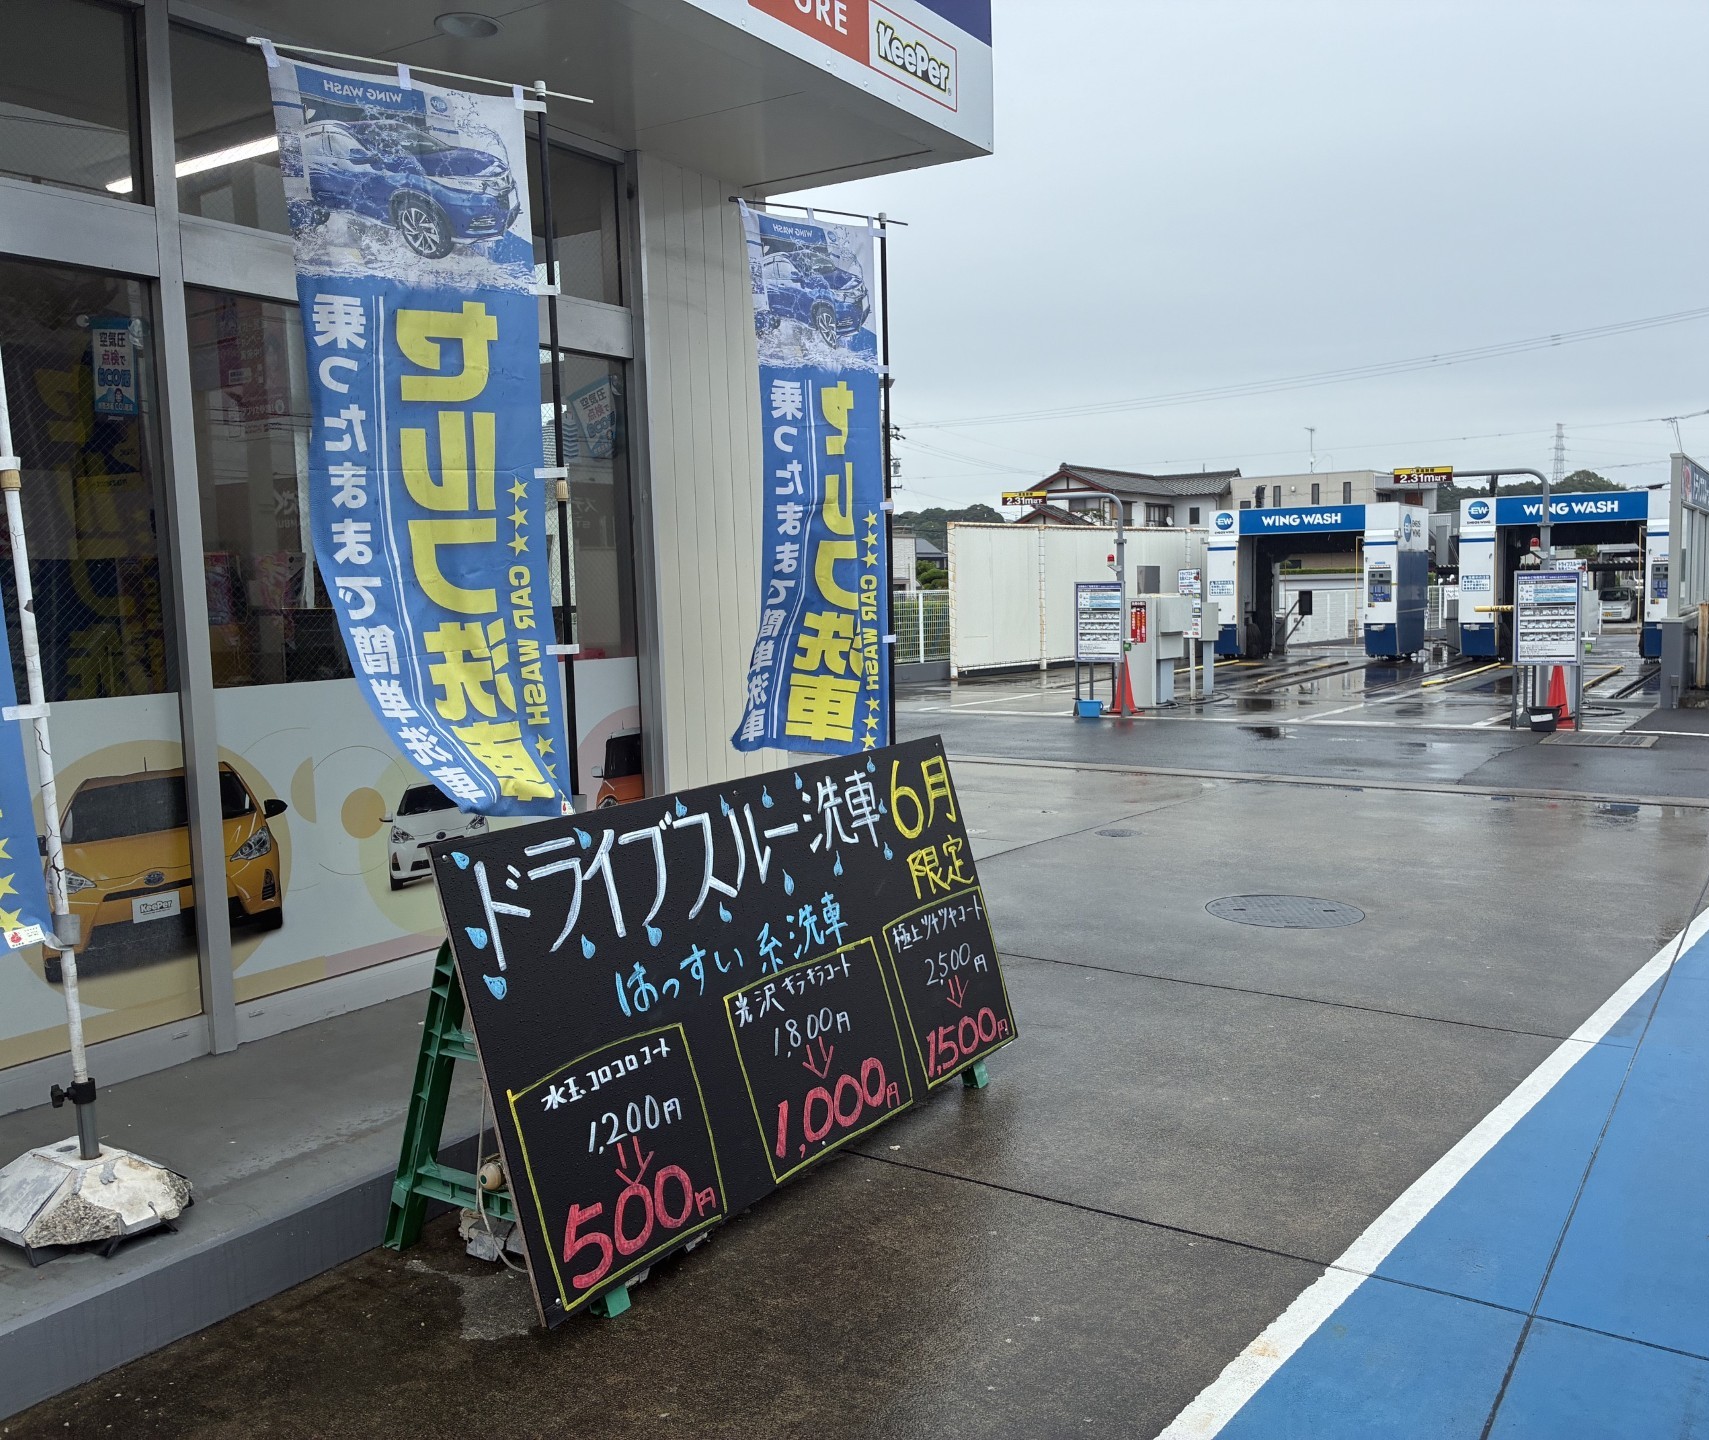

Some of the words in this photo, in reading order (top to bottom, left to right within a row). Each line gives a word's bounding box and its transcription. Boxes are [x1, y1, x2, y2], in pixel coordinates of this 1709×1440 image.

[877, 20, 950, 93] KeePer
[100, 332, 126, 348] 空気圧
[1217, 517, 1233, 526] EW
[1261, 514, 1300, 527] WING
[1302, 512, 1342, 525] WASH
[1470, 506, 1488, 515] EW
[1522, 502, 1570, 516] WING
[1571, 500, 1619, 514] WASH
[890, 755, 957, 840] 6月
[474, 770, 881, 972] ドライブスルー洗車
[906, 834, 974, 900] 限定
[140, 899, 173, 913] KeePer
[924, 942, 988, 986] 2,500円
[774, 1006, 851, 1058] 1,800円
[926, 1006, 1010, 1078] 1,500円
[589, 1094, 683, 1154] 1,200円
[776, 1056, 901, 1159] 1,000円
[563, 1164, 717, 1289] 500円
